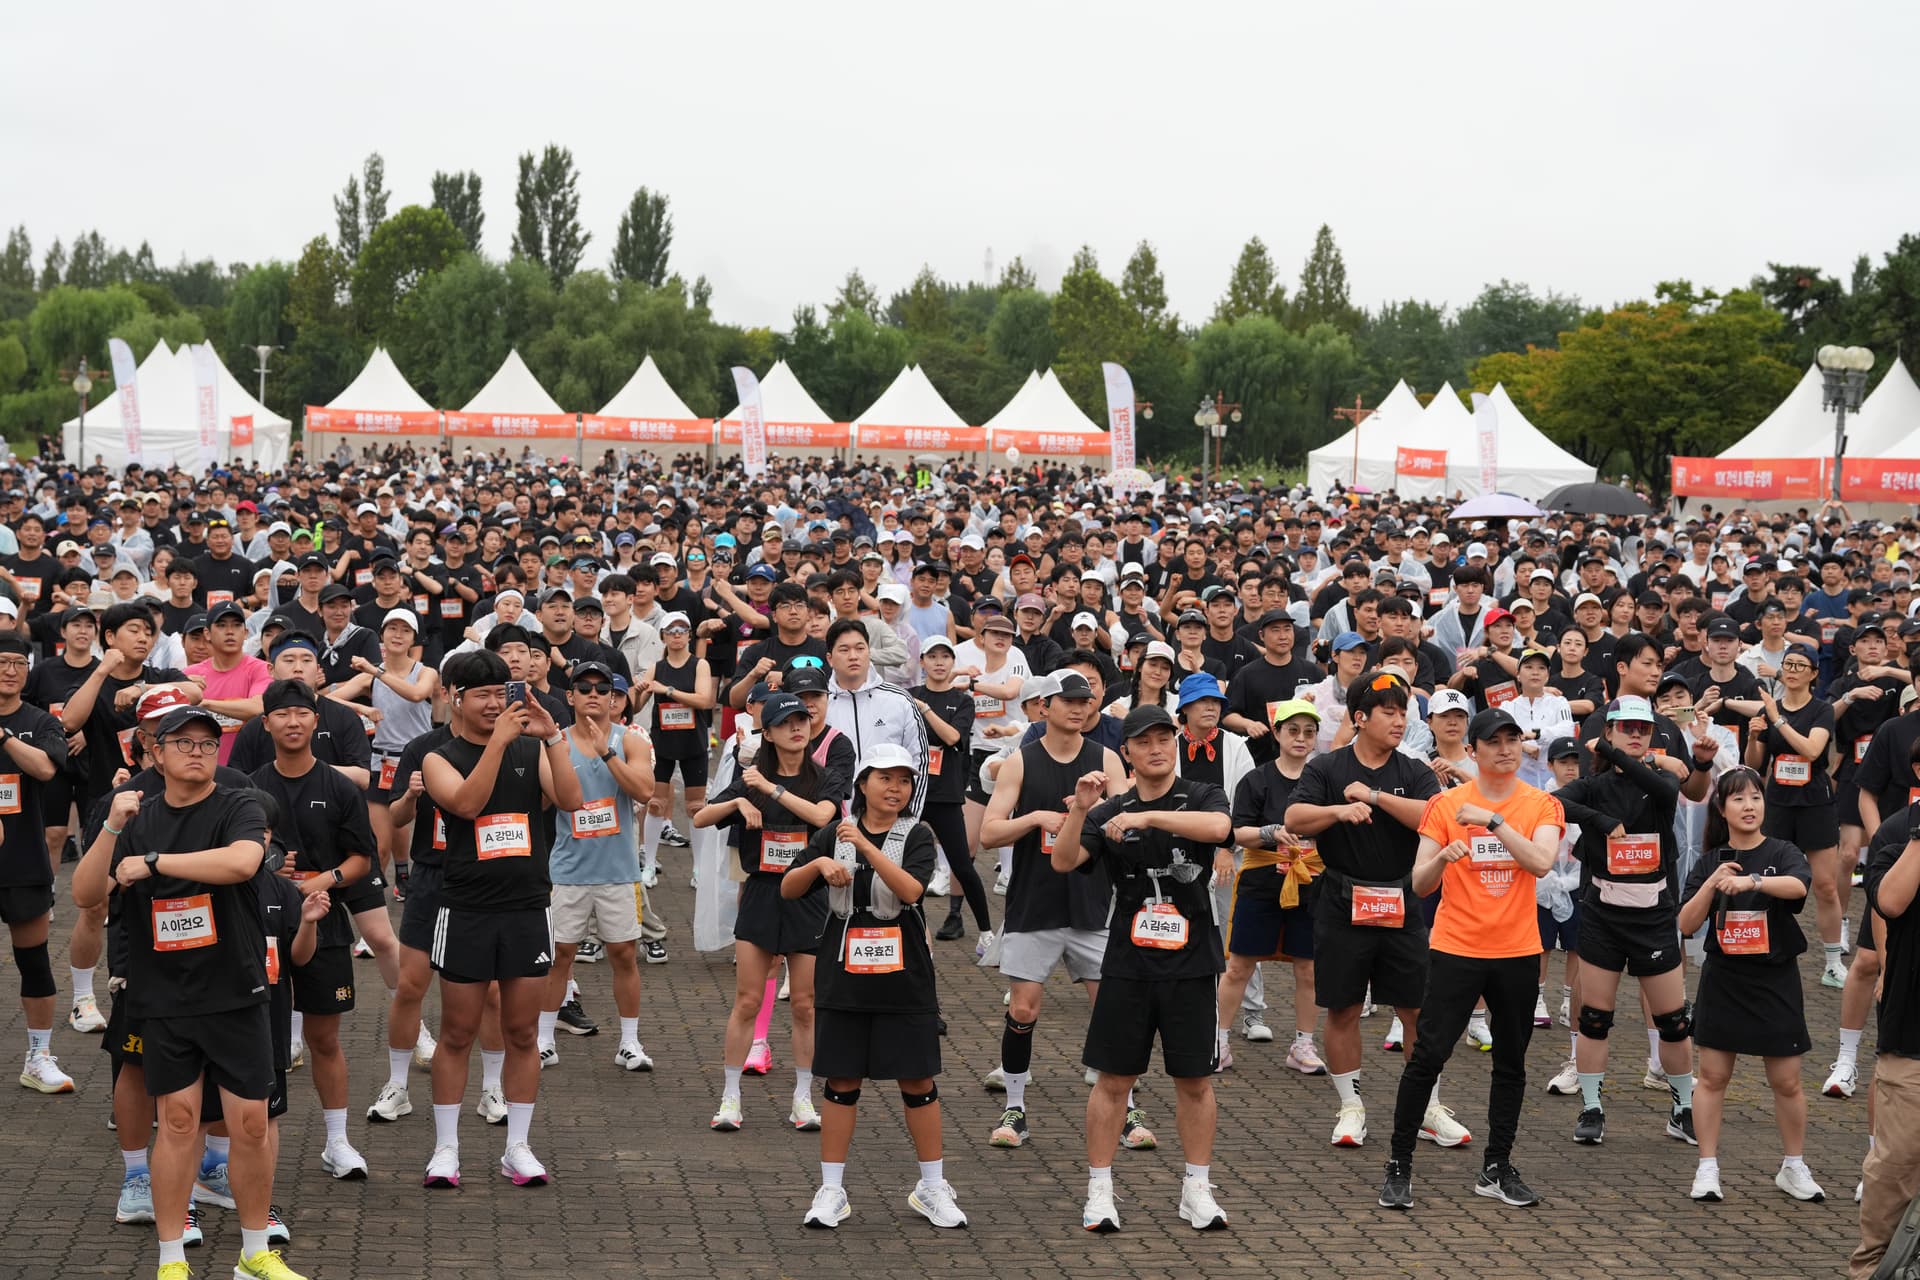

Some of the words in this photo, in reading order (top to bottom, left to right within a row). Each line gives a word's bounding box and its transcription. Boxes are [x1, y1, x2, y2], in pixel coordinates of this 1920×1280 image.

[579, 816, 587, 825] B
[485, 833, 495, 843] A
[495, 830, 524, 842] 강민서
[768, 848, 775, 857] B
[1477, 843, 1486, 854] B
[1616, 850, 1625, 860] A
[1625, 849, 1653, 860] 김지영
[1480, 869, 1514, 883] SEOUL
[1360, 902, 1369, 912] A
[161, 920, 169, 932] A
[170, 916, 205, 931] 이건오
[1139, 919, 1149, 930] A
[1150, 919, 1180, 933] 김숙희
[1724, 928, 1732, 938] A
[1733, 927, 1761, 938] 유선영
[854, 946, 863, 957] A
[864, 945, 894, 957] 유효진
